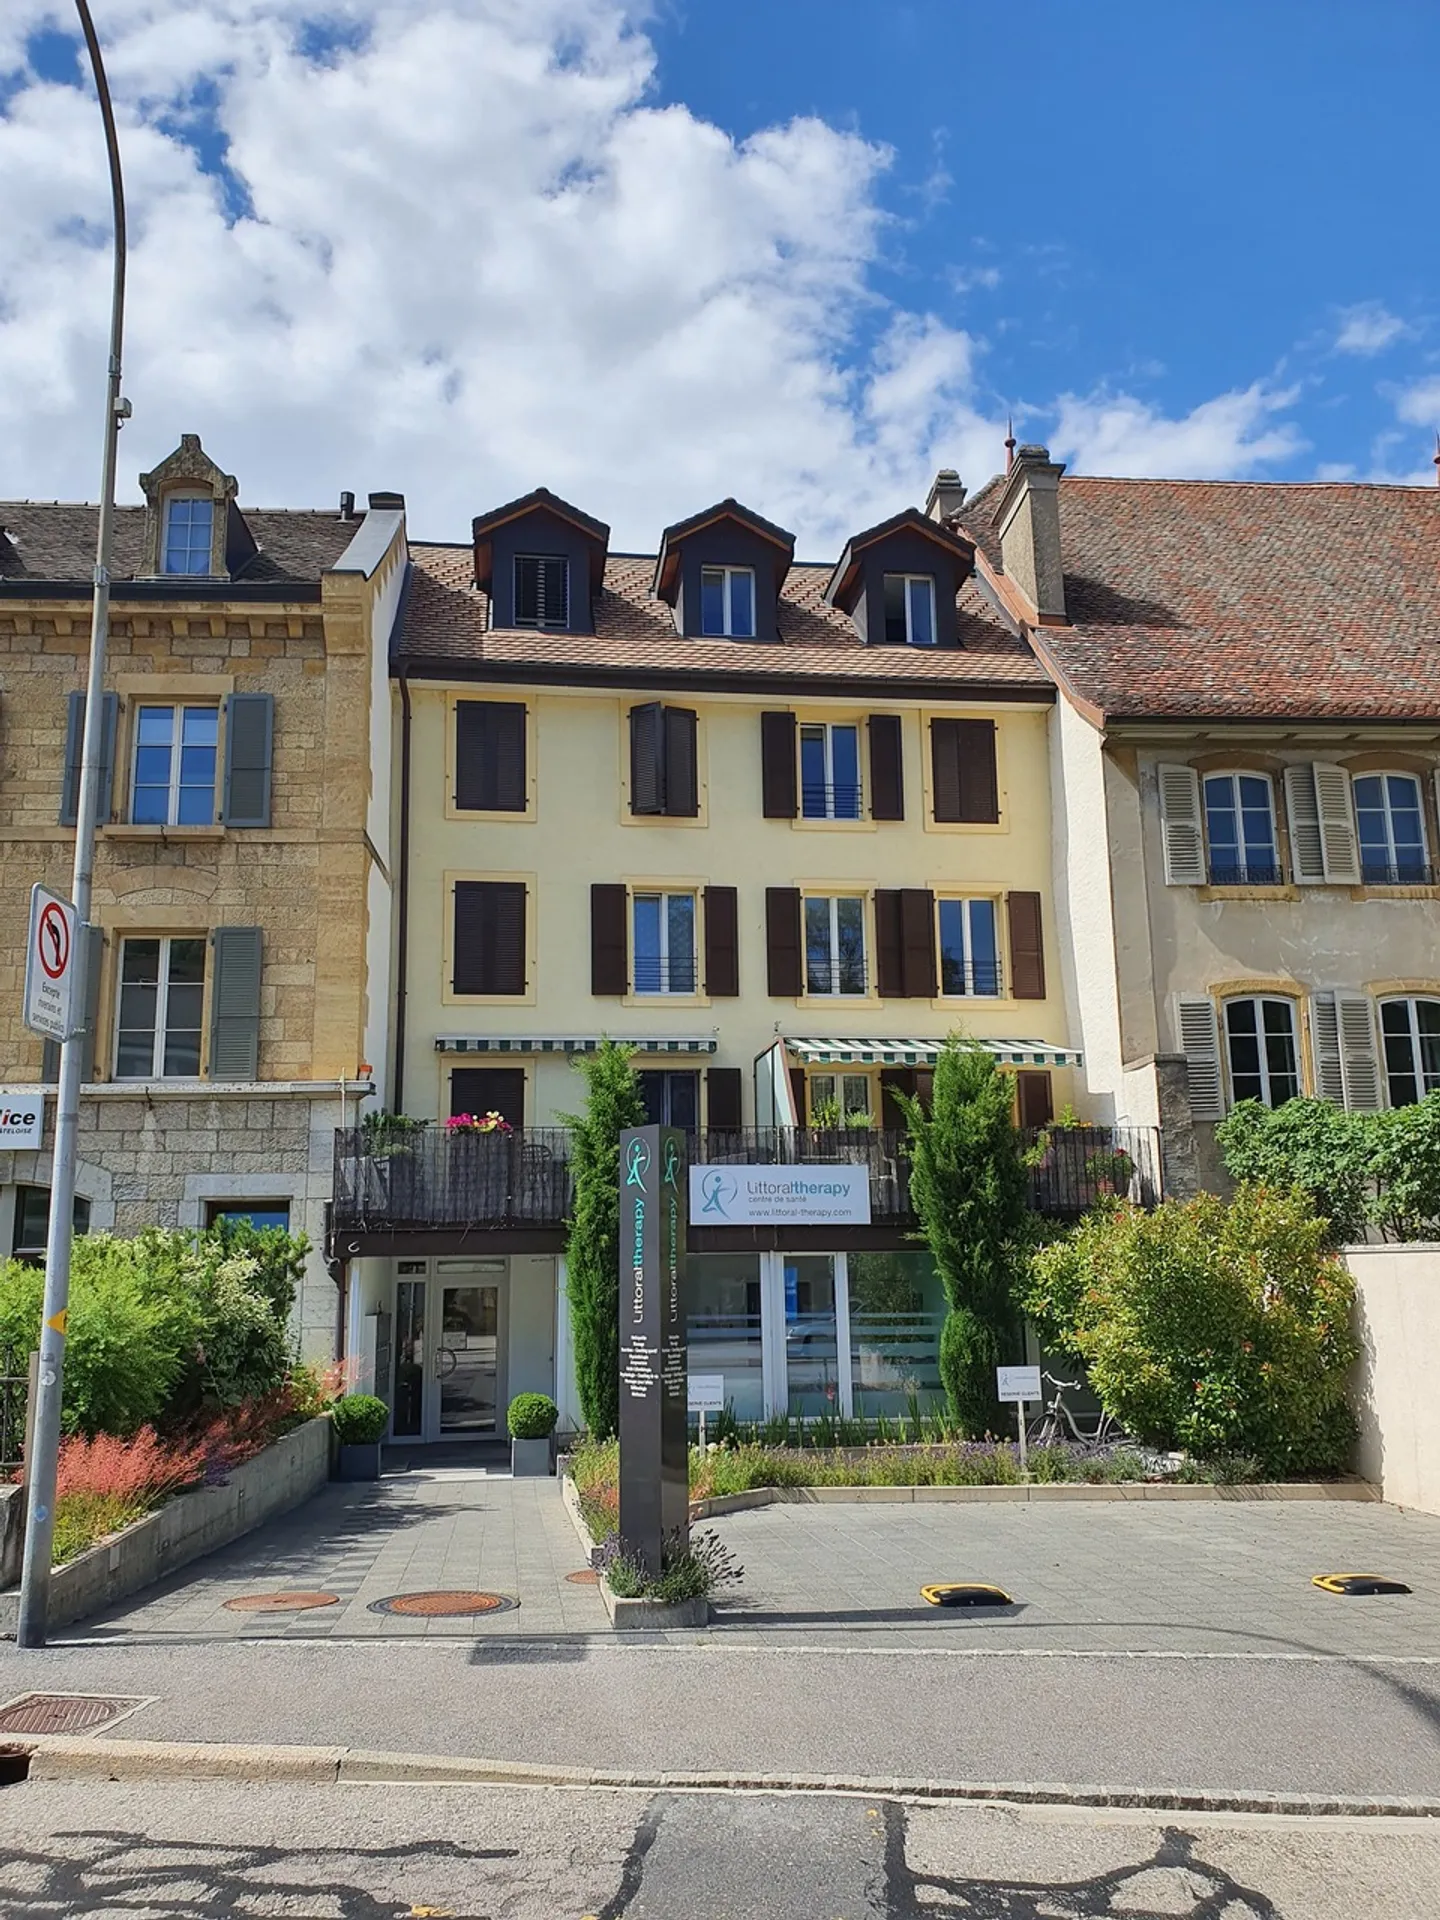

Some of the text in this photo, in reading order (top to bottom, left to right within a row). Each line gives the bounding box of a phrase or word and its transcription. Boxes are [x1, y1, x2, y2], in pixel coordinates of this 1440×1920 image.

[0, 1109, 36, 1125] ice
[747, 1181, 850, 1197] Littoraltherapy
[748, 1208, 852, 1218] www.littoral-therapy.com
[633, 1198, 645, 1323] Littoraltherapy
[670, 1197, 678, 1323] Littoraltherapy
